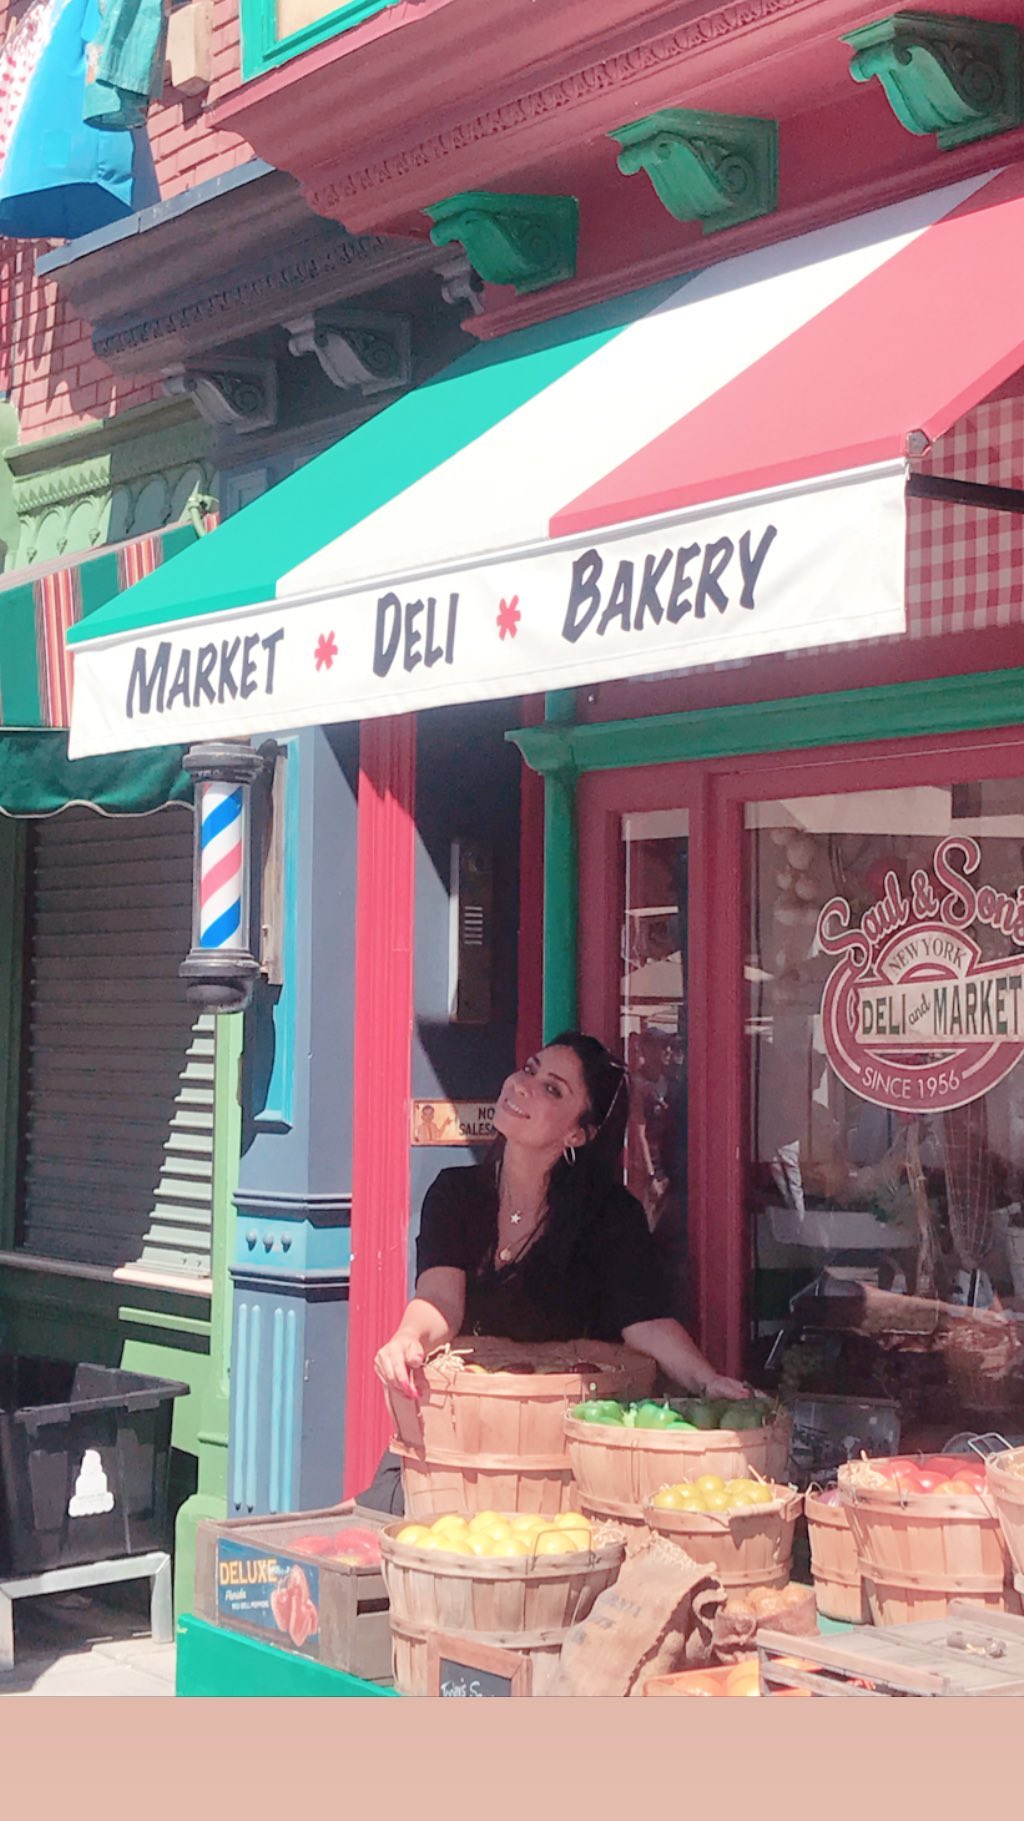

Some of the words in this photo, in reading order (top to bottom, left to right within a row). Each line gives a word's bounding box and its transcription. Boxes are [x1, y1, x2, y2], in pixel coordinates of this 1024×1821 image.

[125, 626, 285, 719] MARKET
[372, 591, 460, 678] DELI
[561, 524, 778, 644] BAKERY
[817, 869, 909, 972] Saul
[911, 869, 940, 919] &
[888, 940, 919, 975] NEW
[921, 938, 967, 969] YORK
[861, 993, 907, 1036] DELI
[907, 992, 932, 1026] and
[933, 974, 1023, 1036] MARKET
[861, 1066, 912, 1099] SINCE
[916, 1068, 961, 1099] 1956
[458, 1122, 495, 1136] SALES
[478, 1106, 496, 1121] NO
[219, 1558, 278, 1586] DELUXE
